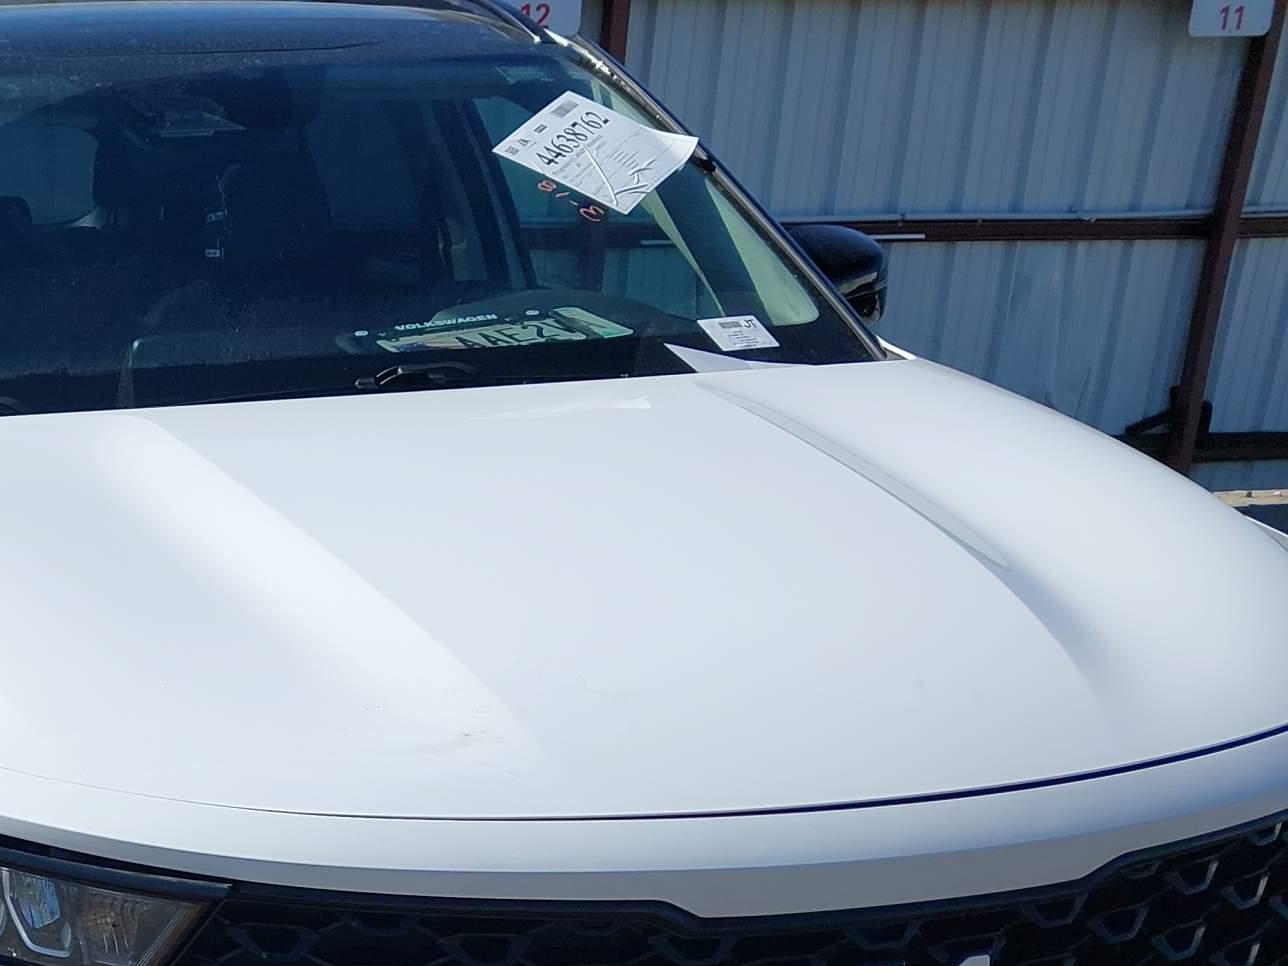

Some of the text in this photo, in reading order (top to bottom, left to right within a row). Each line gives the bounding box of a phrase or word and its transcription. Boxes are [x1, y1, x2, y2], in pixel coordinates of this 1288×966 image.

[521, 3, 550, 30] 12
[1220, 5, 1246, 31] 11
[535, 111, 610, 166] 44638762
[394, 313, 498, 331] VOLKSWAGEN
